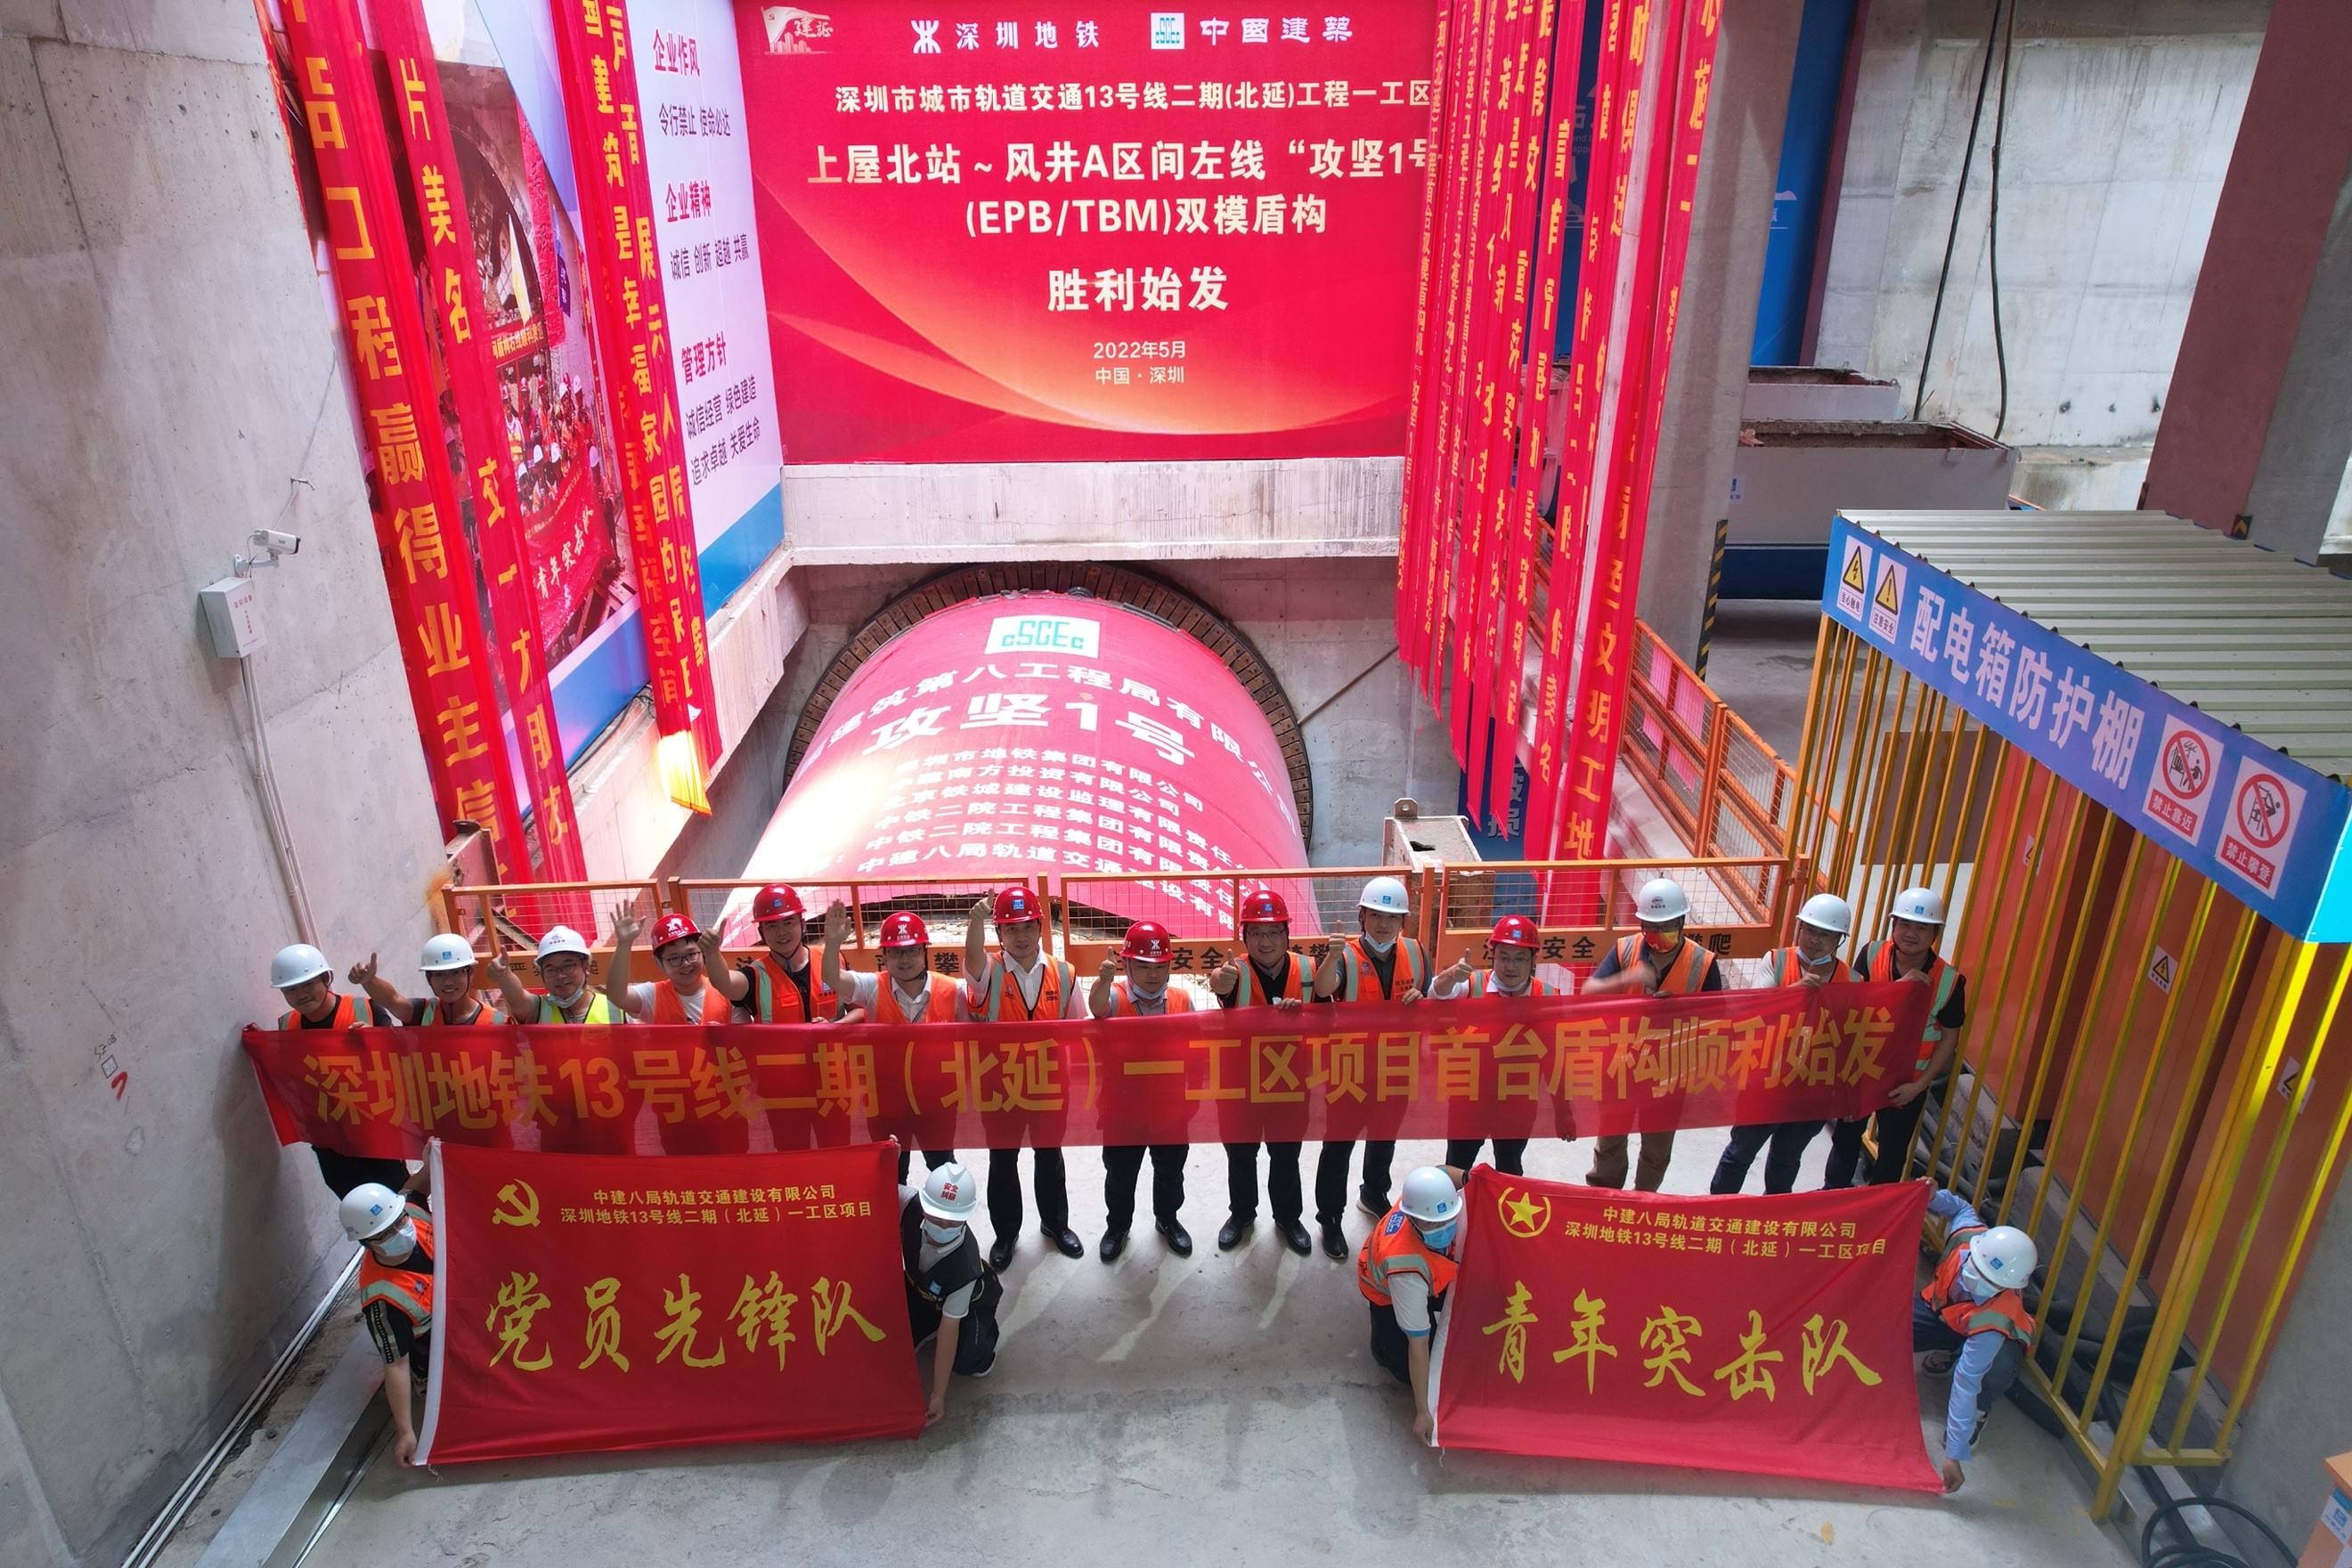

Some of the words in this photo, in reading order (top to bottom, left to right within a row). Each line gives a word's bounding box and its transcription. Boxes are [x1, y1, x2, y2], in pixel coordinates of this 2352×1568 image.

[653, 28, 700, 77] 企业作风
[955, 20, 1100, 50] 深圳地铁
[659, 102, 697, 136] 令行禁止
[700, 106, 730, 136] 使命必达
[665, 179, 711, 223] 企业精神
[965, 193, 1326, 237] (EPB/TBM)双模盾构
[670, 247, 690, 281] 诚信
[694, 241, 712, 274] 创新
[714, 236, 731, 269] 超越
[733, 232, 750, 263] 共赢
[1046, 266, 1229, 312] 胜利始发
[681, 331, 727, 386] 管理方针
[1093, 340, 1186, 359] 2022年5月
[685, 394, 723, 440] 诚信经营
[725, 373, 757, 415] 绿色建造
[690, 436, 728, 487] 追求卓越
[729, 415, 761, 459] 关爱生命
[1872, 612, 1894, 635] 注意安全
[1908, 583, 2144, 791] 配电箱防护棚
[861, 692, 1196, 767] 攻坚1号
[2152, 794, 2193, 832] 禁止靠近
[2225, 841, 2272, 883] 禁止攀登
[593, 1184, 835, 1206] 中建八局轨道交通建设有限公司
[943, 1182, 958, 1193] 安全
[560, 1201, 872, 1226] 深圳地铁13号线二期（北延）一工区项目
[1602, 1205, 1857, 1239] 中建八局轨道交通建设有限公司
[485, 1271, 888, 1374] 党员先锋队
[1481, 1280, 1884, 1403] 青年突击队
